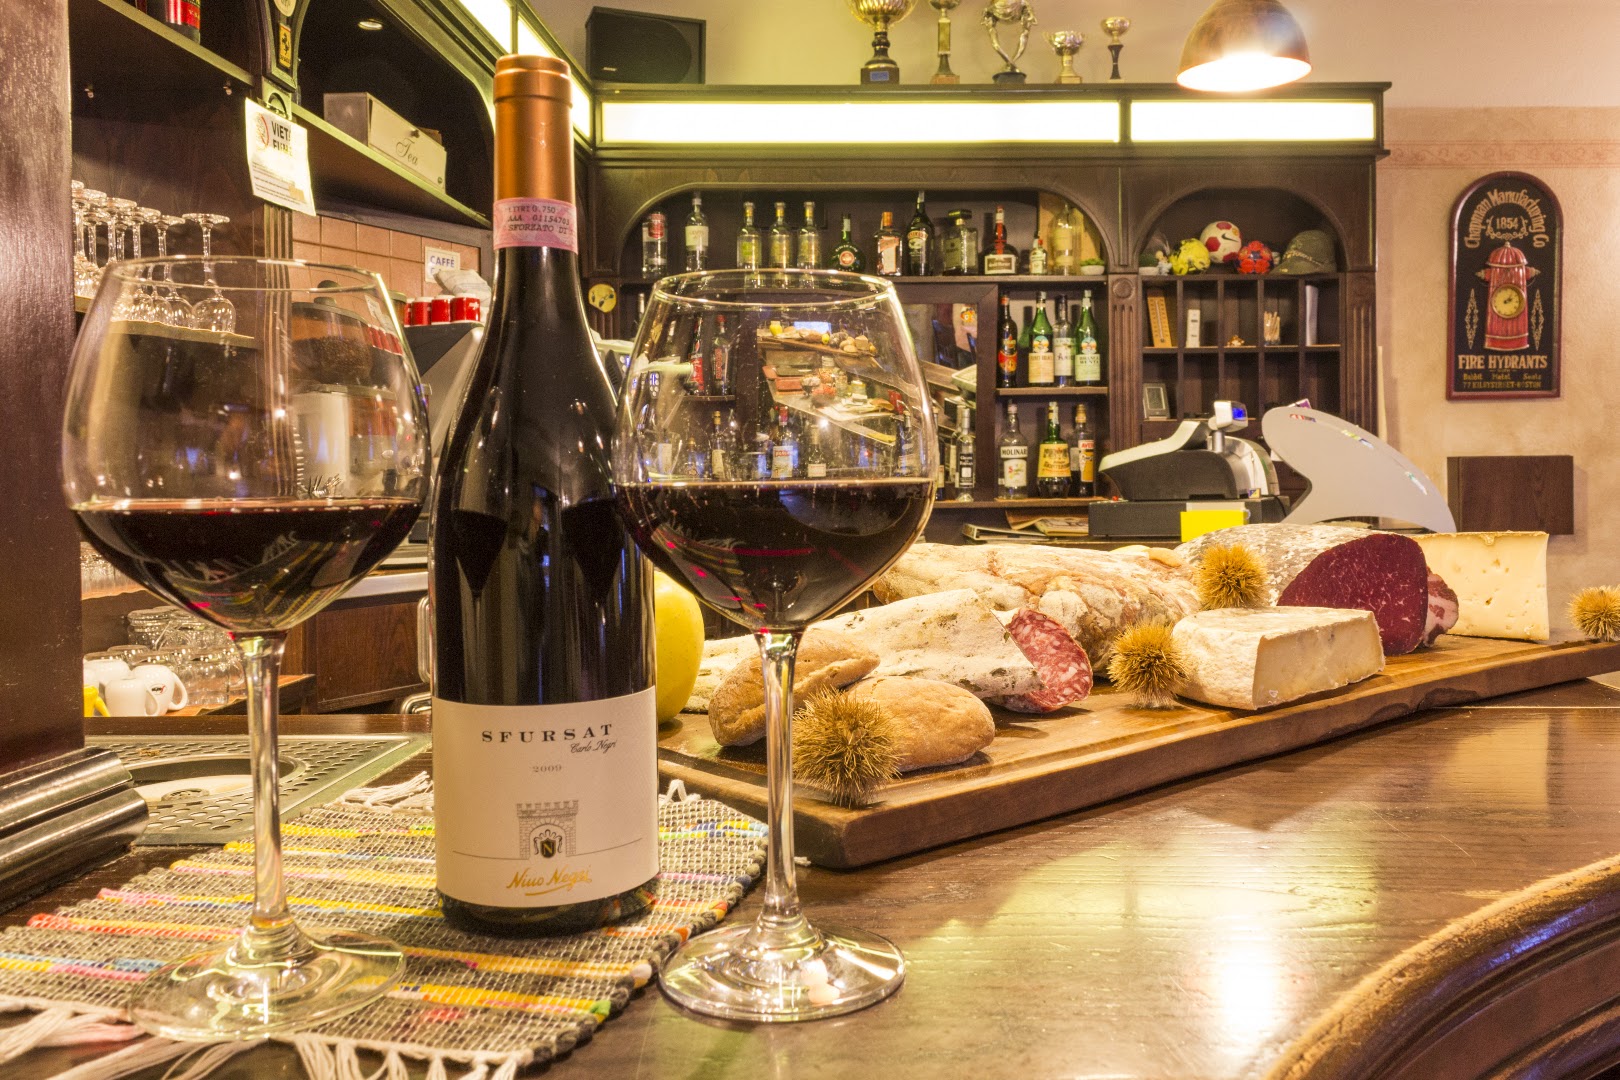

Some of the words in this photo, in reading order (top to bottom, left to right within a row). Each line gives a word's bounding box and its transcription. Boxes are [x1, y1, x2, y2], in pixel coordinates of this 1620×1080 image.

[396, 138, 419, 166] Tea
[1464, 199, 1492, 248] Chapman
[1487, 189, 1547, 233] Manufacturing
[1496, 216, 1518, 229] 1854
[508, 224, 555, 233] SFORZATO
[1458, 354, 1485, 370] FIRE
[1488, 354, 1548, 369] HYDRANTS
[481, 723, 613, 743] SFURSAT
[570, 740, 592, 754] Carlo
[532, 763, 563, 773] 2009
